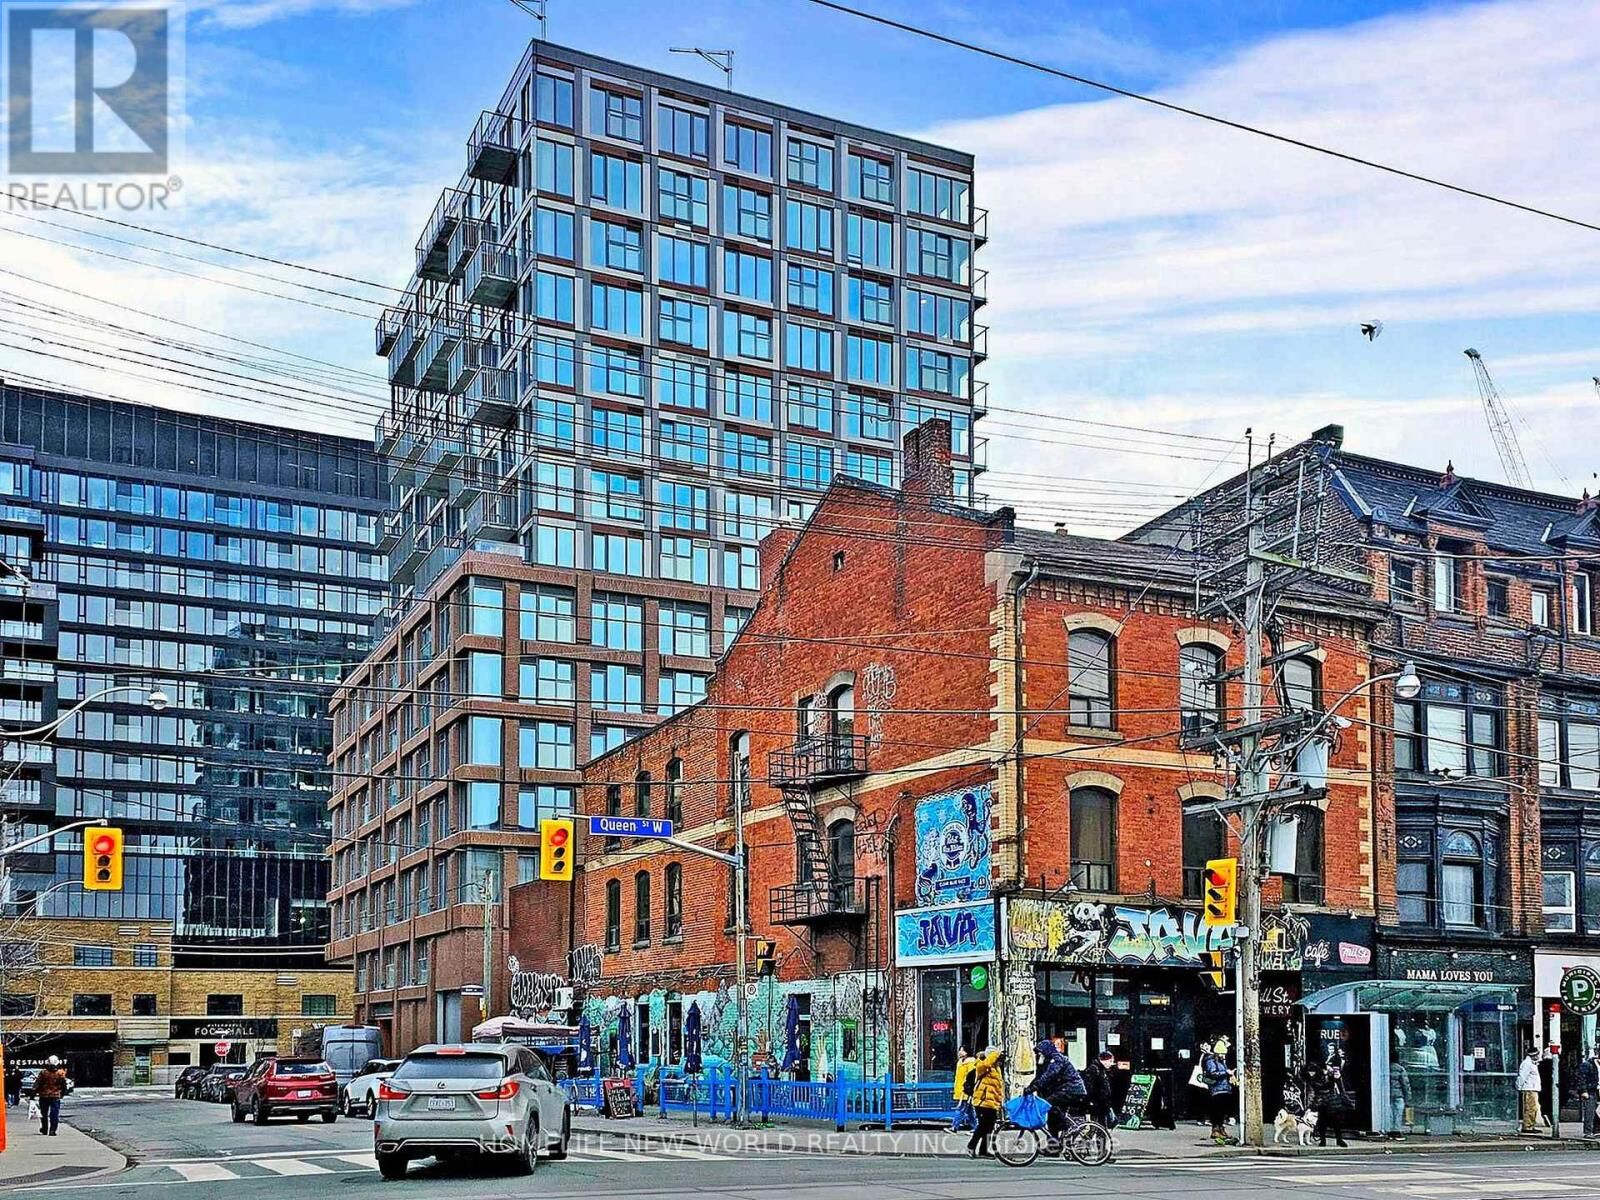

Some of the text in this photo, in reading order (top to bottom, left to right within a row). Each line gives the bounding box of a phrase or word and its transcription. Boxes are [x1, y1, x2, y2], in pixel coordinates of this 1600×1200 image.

[600, 818, 636, 832] Queen
[653, 821, 662, 832] W
[917, 911, 978, 950] JAVA
[1406, 970, 1494, 982] MAMA LOVES YOU
[1273, 986, 1292, 1003] St.
[1572, 979, 1589, 998] P
